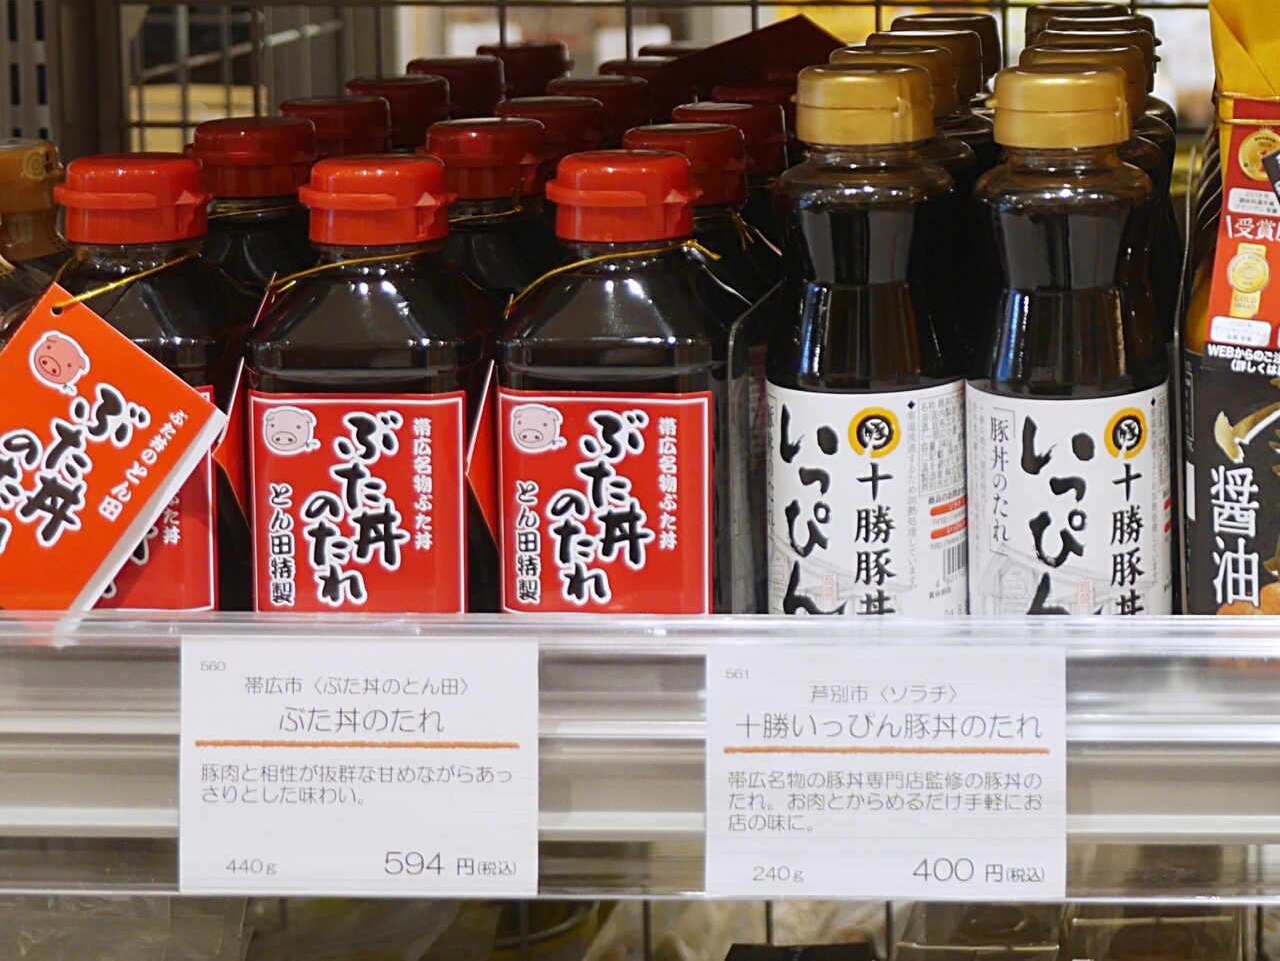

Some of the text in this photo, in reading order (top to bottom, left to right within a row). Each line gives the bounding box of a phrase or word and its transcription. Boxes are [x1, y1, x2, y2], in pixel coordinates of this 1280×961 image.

[412, 418, 433, 550] 帯広名物ぶた丼
[658, 417, 677, 549] 帯広名物ぶた丼
[990, 416, 1010, 543] 豚丼のたれ
[269, 483, 296, 607] とん田特製
[516, 481, 541, 604] とん田特製
[1210, 465, 1260, 608] 醤油
[200, 661, 226, 672] 560
[725, 669, 750, 679] 561
[279, 707, 445, 733] ぶた丼のたれ
[735, 712, 1043, 739] 十勝いっぴん豚丼のたれ
[201, 765, 512, 783] 豚肉と相性が抜群な甘めながらあっ
[728, 771, 1042, 789] 帯広名物の豚丼専門店監修の豚丼の
[201, 786, 365, 805] さりとした味わい。
[728, 793, 1042, 811] たれ。お肉とからめるだけ手軽にお
[728, 815, 814, 833] 店の味に。
[384, 851, 446, 875] 594
[912, 858, 974, 882] 400
